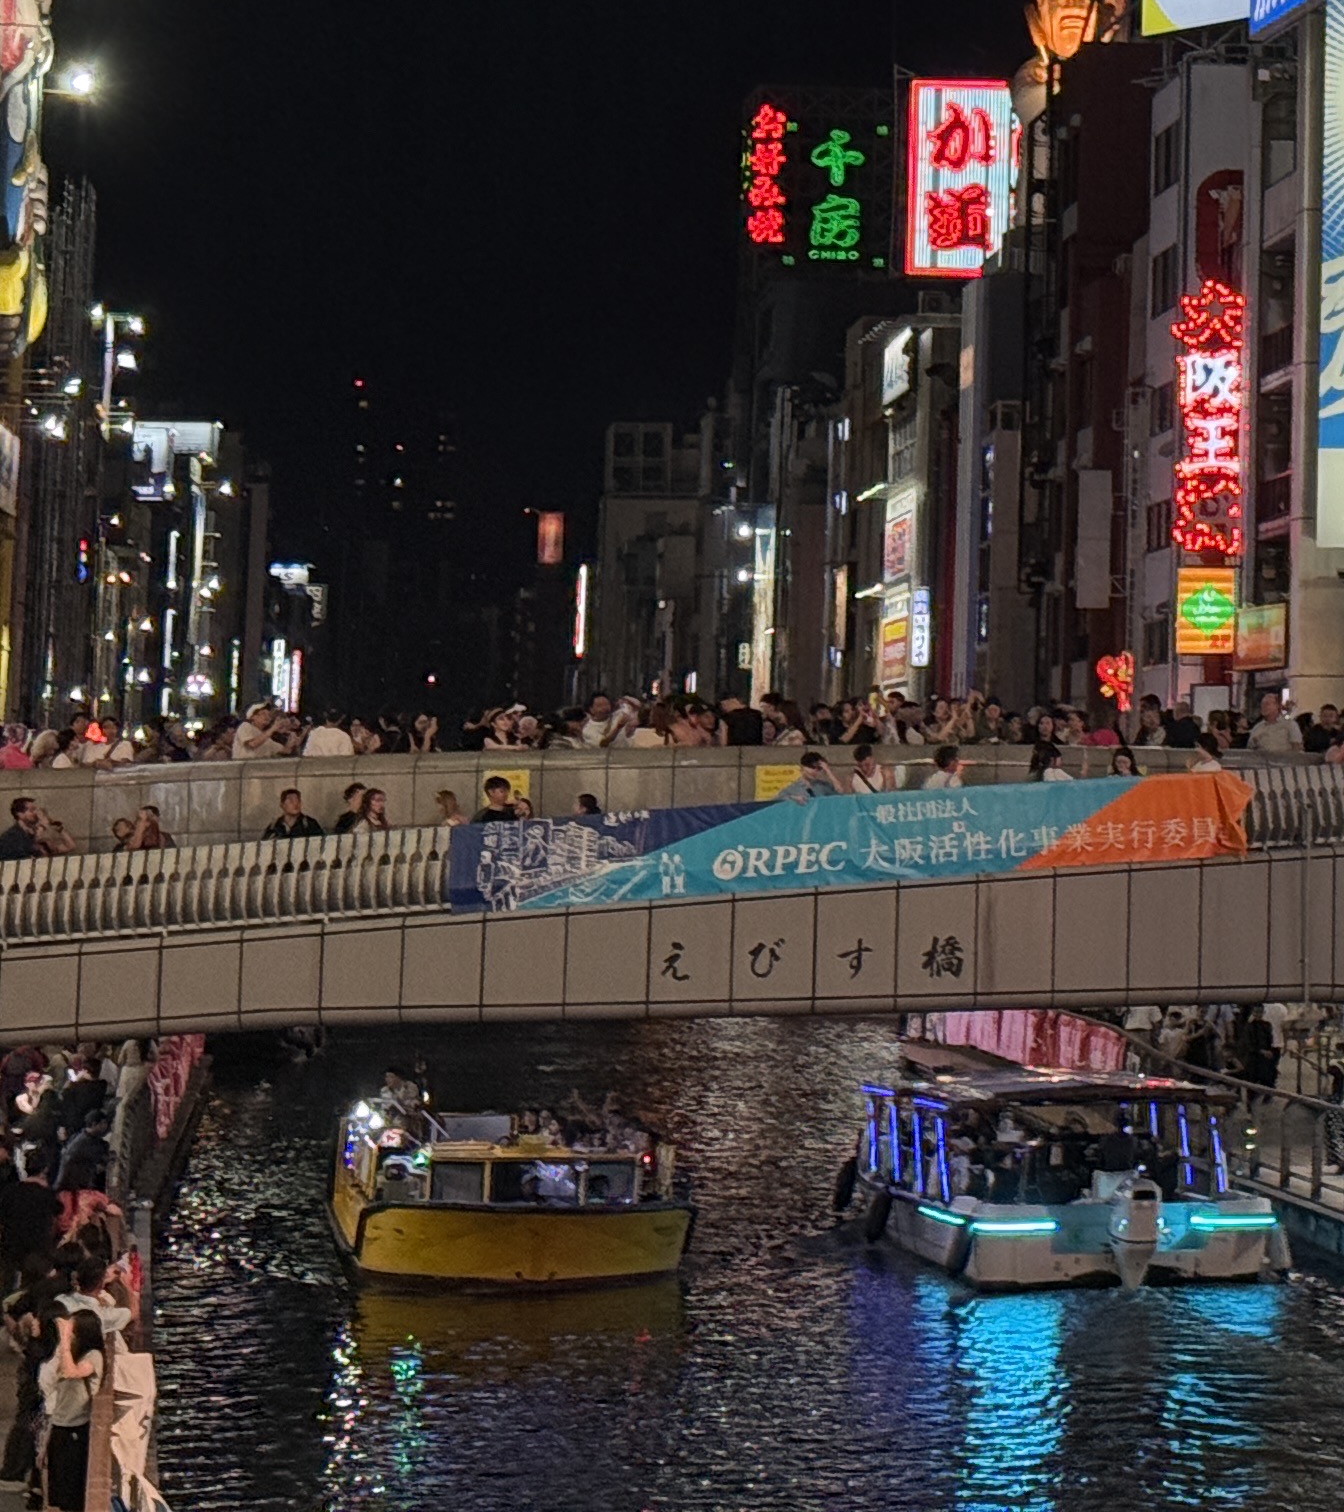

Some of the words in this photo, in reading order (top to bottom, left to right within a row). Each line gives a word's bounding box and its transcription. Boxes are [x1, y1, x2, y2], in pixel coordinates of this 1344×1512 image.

[860, 816, 1228, 868] 大阪活性化事業実行委員
[660, 934, 965, 983] えびす橋
